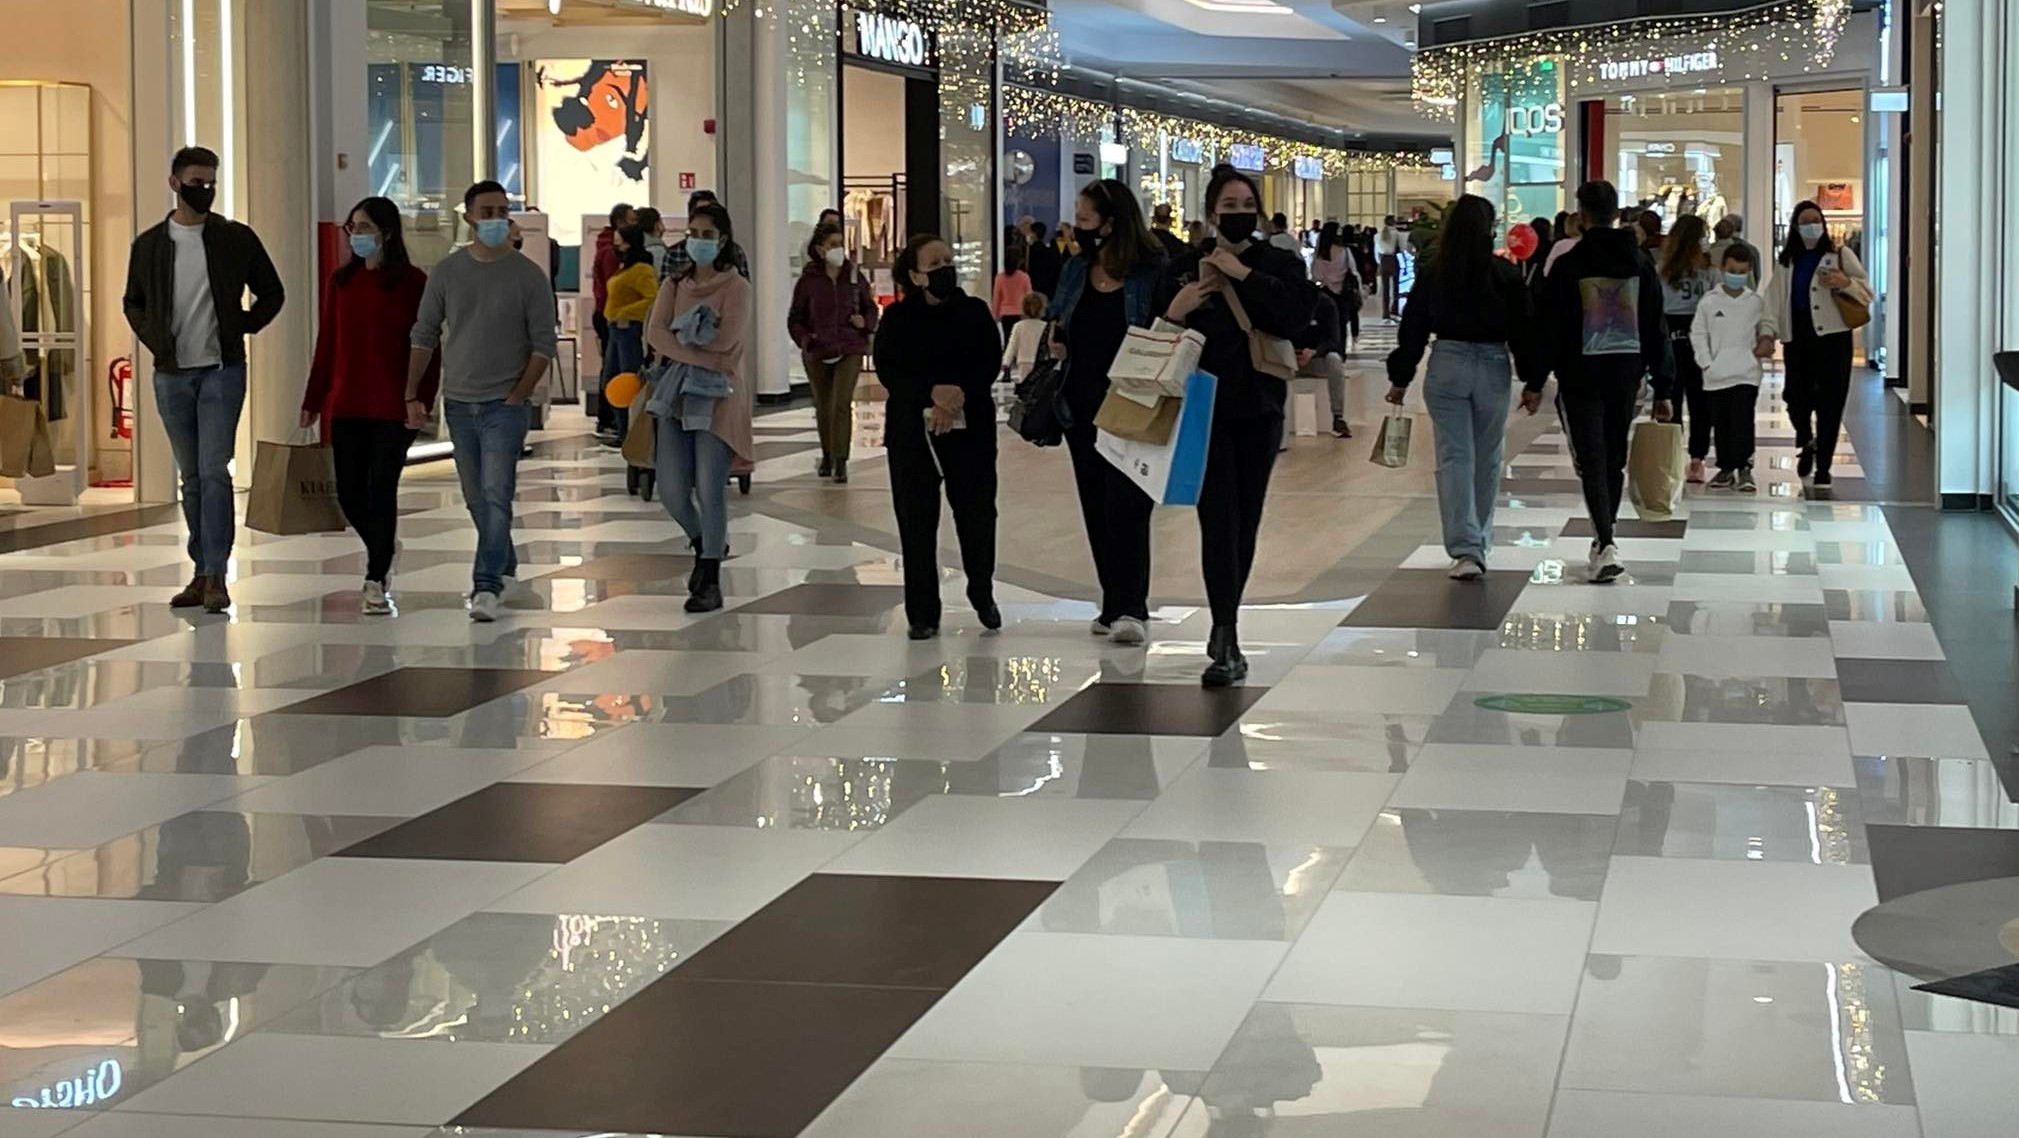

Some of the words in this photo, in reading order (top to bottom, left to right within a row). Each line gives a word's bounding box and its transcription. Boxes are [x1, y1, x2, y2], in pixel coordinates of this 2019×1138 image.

[859, 12, 923, 65] MANGO
[1599, 60, 1648, 79] TOMMY
[1664, 52, 1718, 73] HILFIGER
[1505, 102, 1562, 137] IQOS
